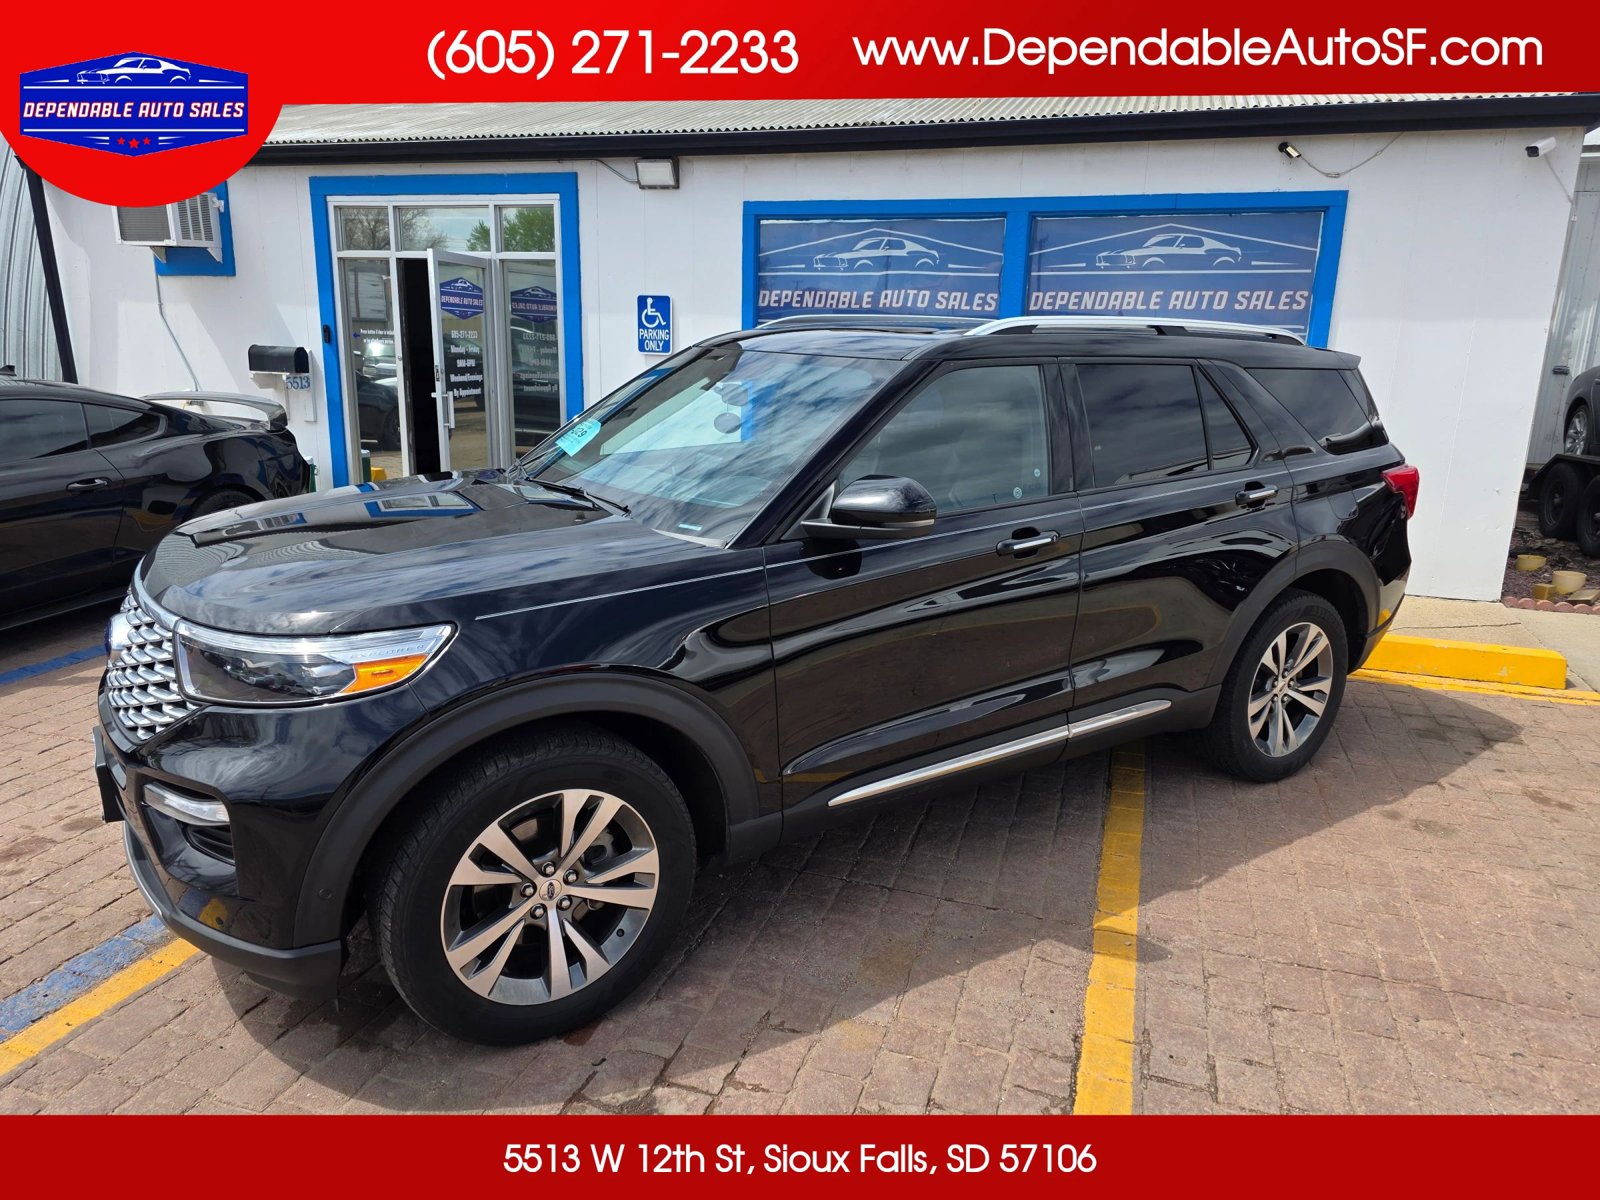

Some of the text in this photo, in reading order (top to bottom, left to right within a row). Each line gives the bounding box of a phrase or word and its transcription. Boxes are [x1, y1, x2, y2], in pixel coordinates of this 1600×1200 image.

[441, 295, 483, 307] DEPENDABLE AUTO SALES
[758, 290, 998, 311] DEPENDABLE AUTO SALES
[1029, 290, 1309, 311] DEPENDABLE AUTO SALES
[639, 329, 670, 340] PARKING
[450, 345, 466, 355] Monday
[644, 340, 664, 351] ONLY
[285, 375, 310, 390] 5513
